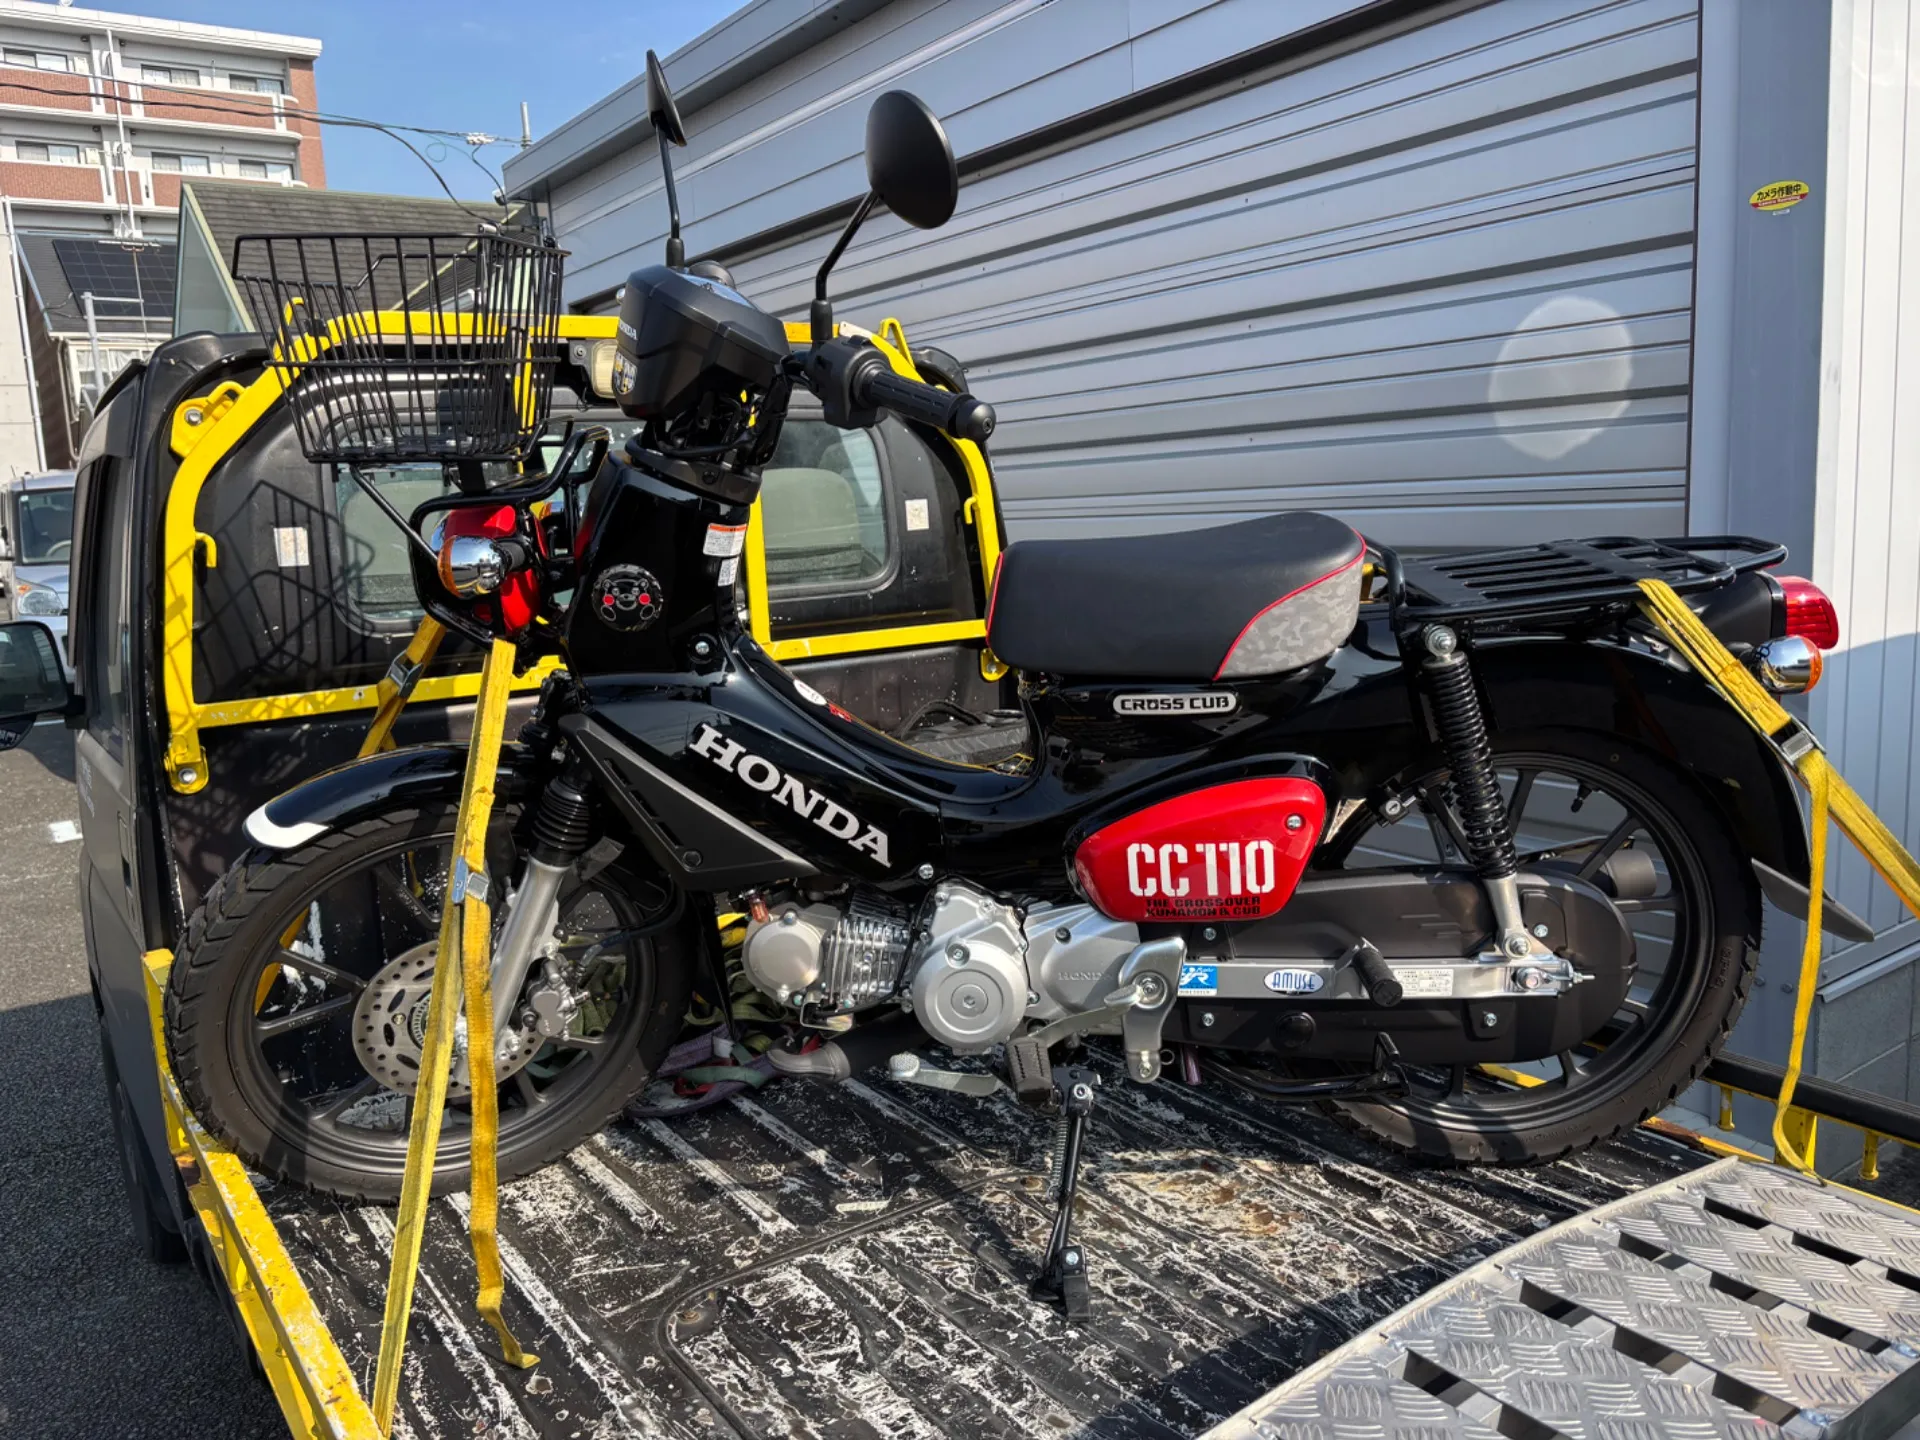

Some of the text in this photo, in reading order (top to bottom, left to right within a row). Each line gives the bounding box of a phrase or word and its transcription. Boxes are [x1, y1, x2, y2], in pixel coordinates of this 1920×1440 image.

[1757, 184, 1801, 201] カメラ作動中
[1120, 696, 1230, 711] CROSS CUB
[689, 723, 892, 868] HONDA
[1146, 897, 1260, 907] THE CROSSOVER
[1146, 906, 1260, 917] KUMAMON & CUB
[1271, 972, 1316, 990] AMUSE
